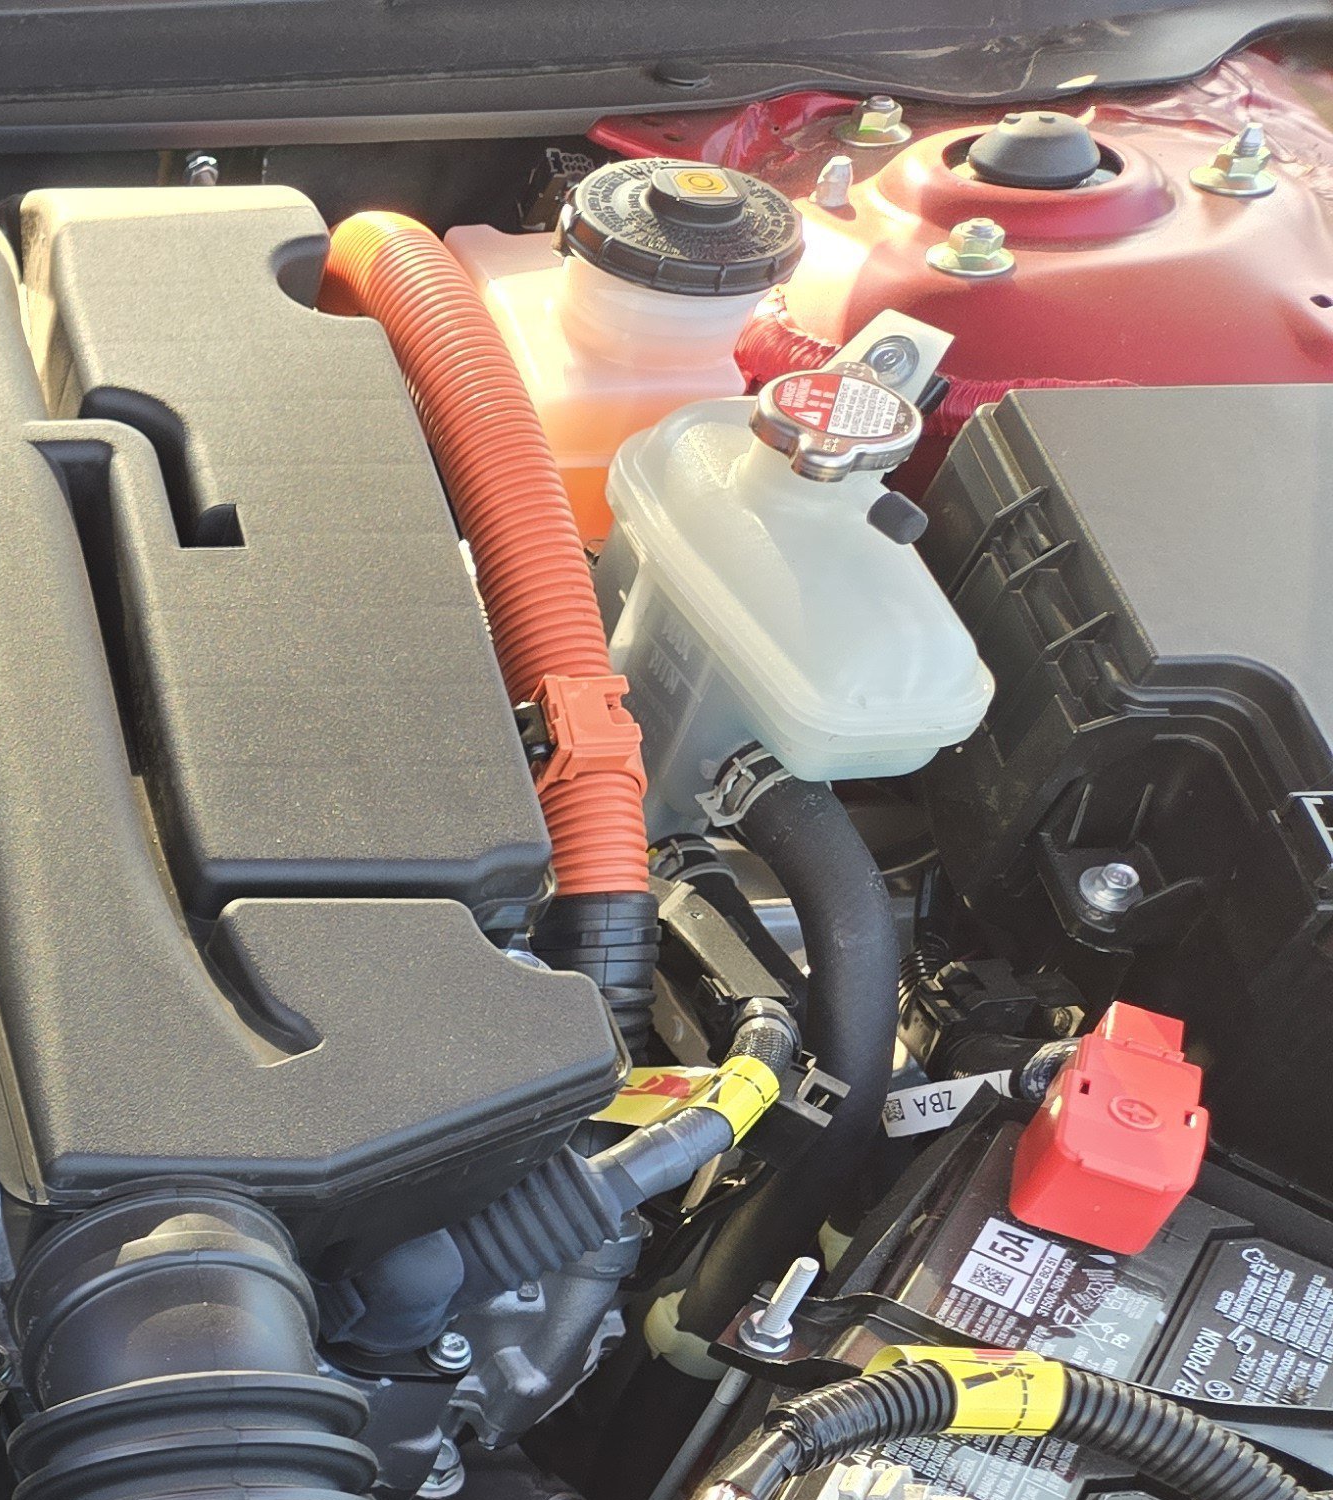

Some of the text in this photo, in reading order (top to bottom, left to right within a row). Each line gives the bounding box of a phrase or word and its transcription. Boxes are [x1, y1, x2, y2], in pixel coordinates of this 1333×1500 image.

[913, 1090, 957, 1117] ZBA
[987, 1222, 1034, 1267] 5A
[1023, 1254, 1058, 1305] GROUP BCI 51
[1110, 1329, 1131, 1350] Pb
[908, 1437, 936, 1472] LOS GASES
[923, 1440, 952, 1478] EXPLOSIVOS
